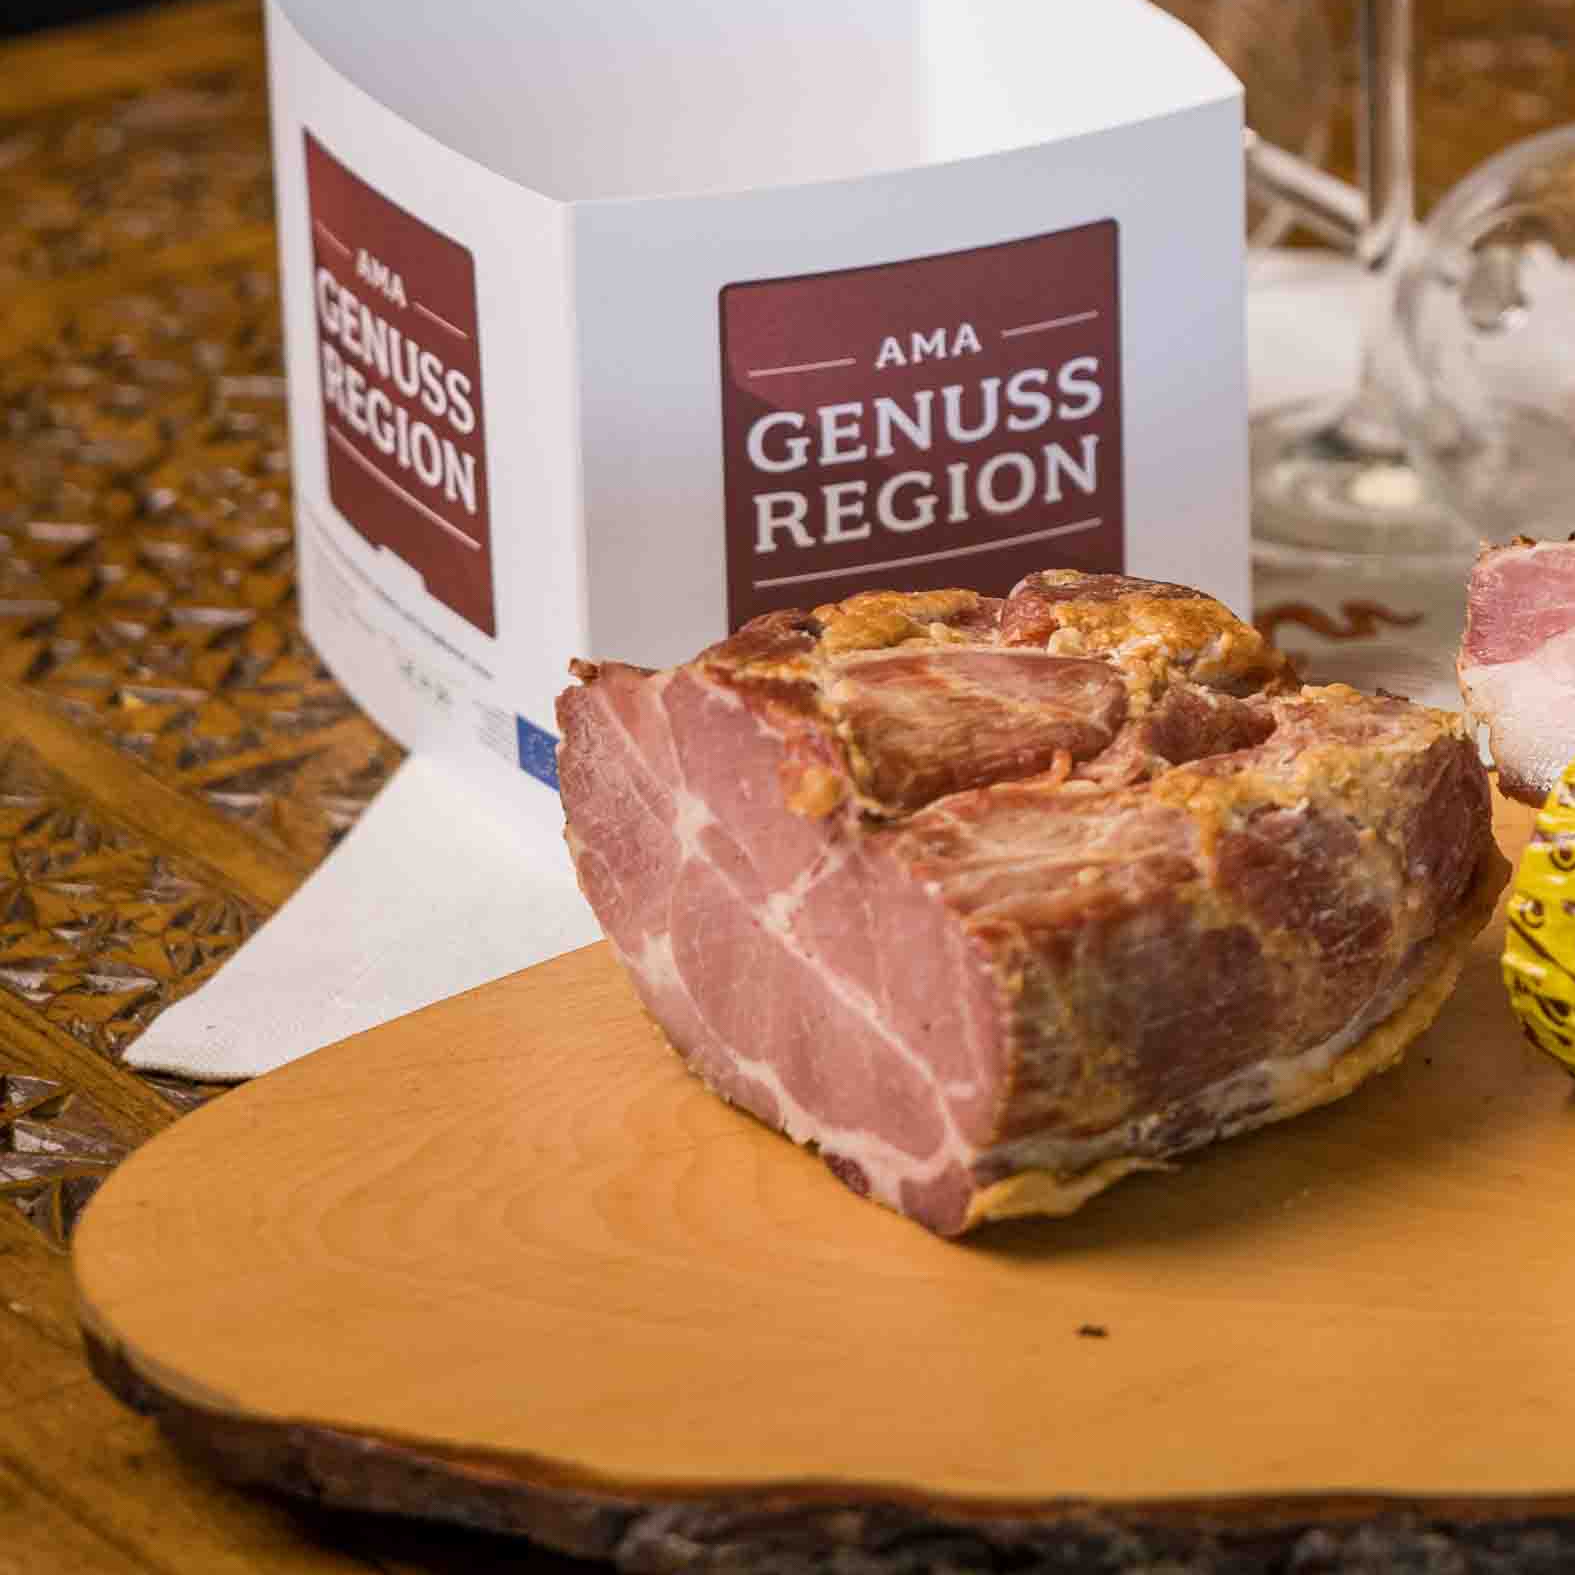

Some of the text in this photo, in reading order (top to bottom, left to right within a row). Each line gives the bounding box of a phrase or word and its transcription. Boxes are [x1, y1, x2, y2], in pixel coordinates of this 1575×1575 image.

[355, 247, 409, 308] AMA
[316, 266, 476, 436] GENUSS
[874, 322, 983, 370] AMA
[322, 340, 477, 516] REGION
[746, 355, 1103, 473] GENUSS
[753, 432, 1100, 554] REGION
